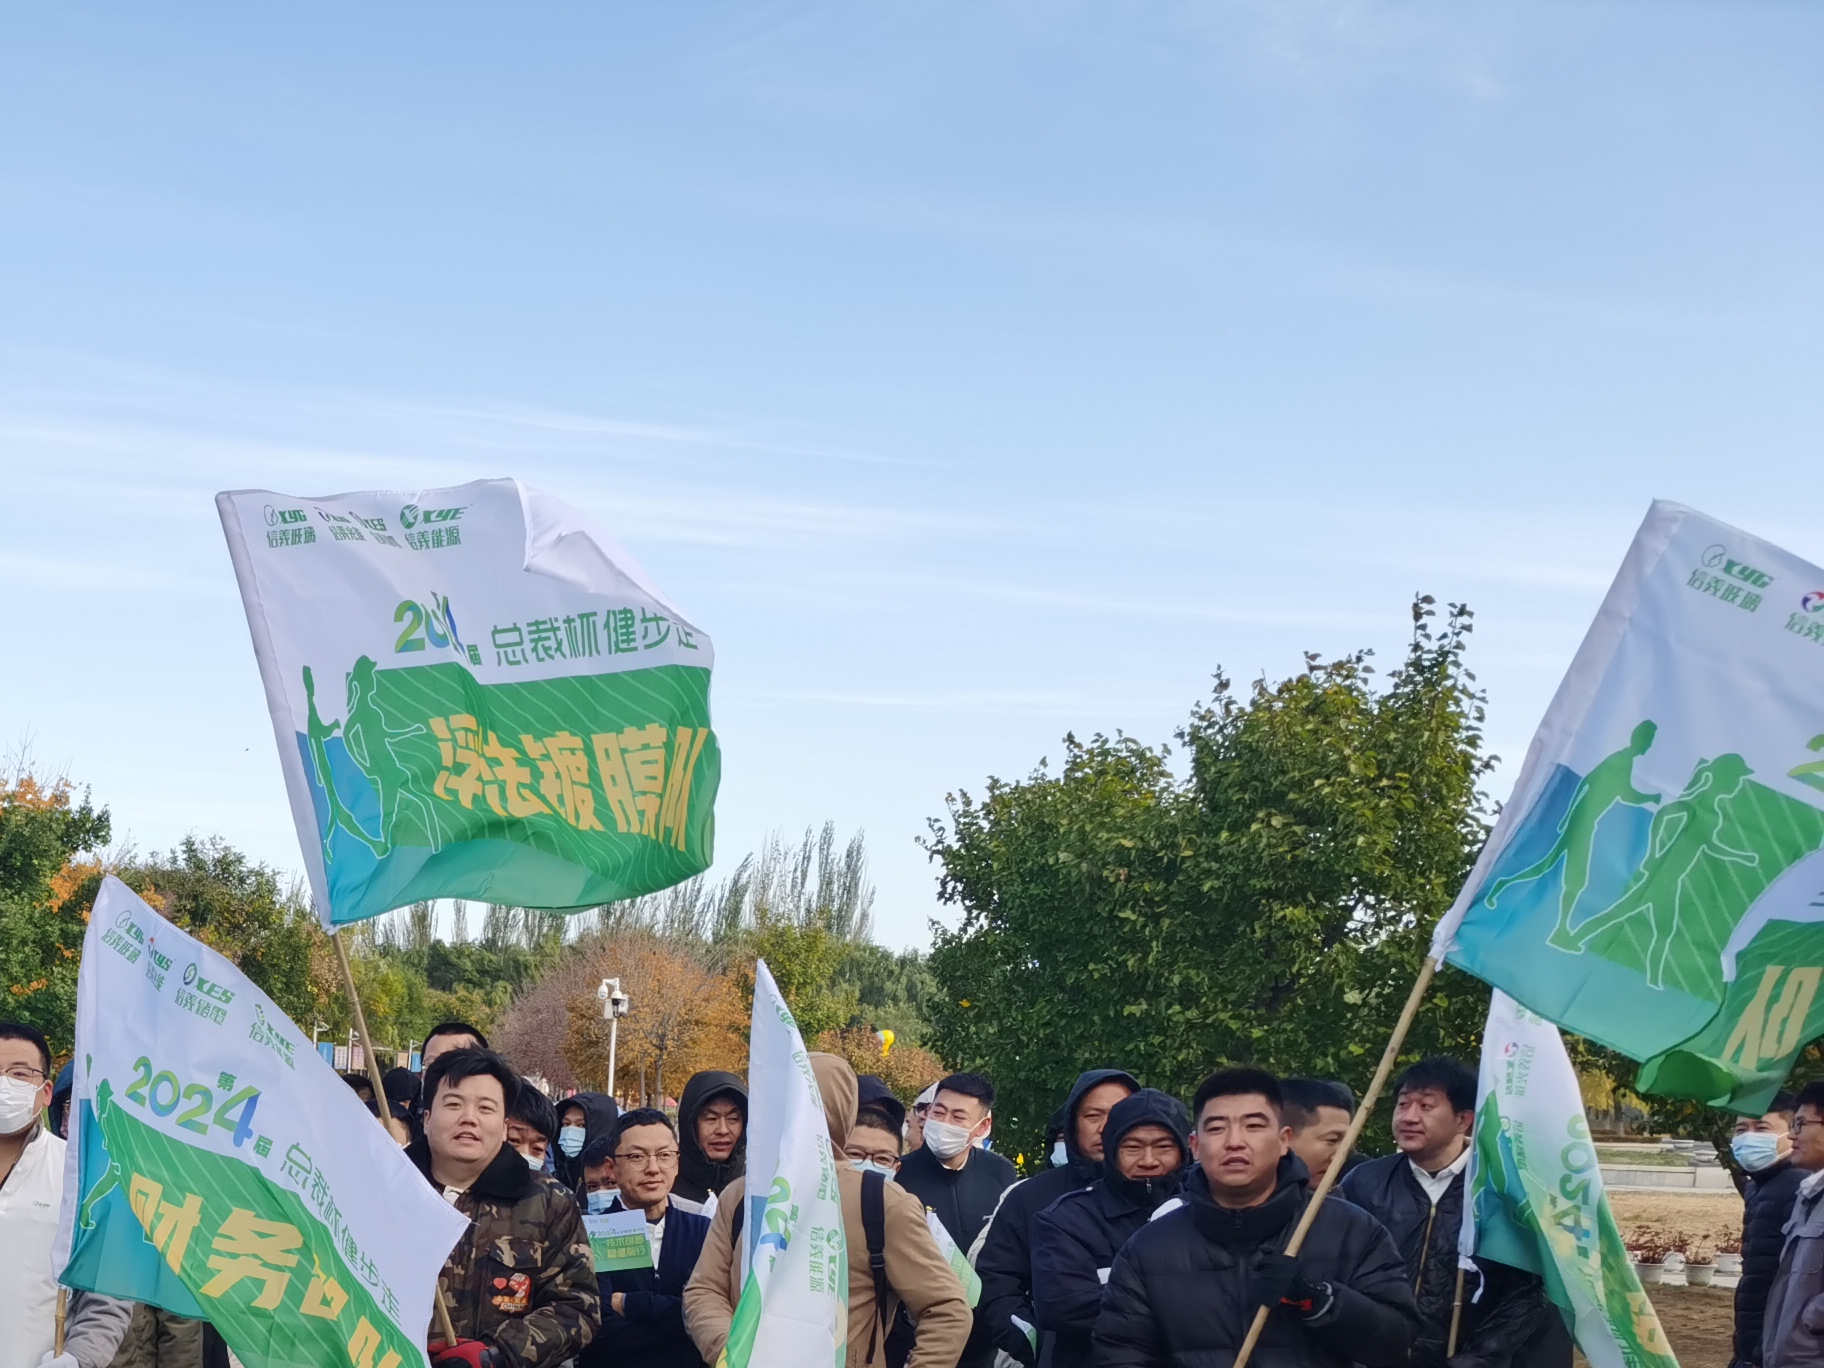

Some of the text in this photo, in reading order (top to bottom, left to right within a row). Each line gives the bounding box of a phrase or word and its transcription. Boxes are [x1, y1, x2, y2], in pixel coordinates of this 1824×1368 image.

[124, 1056, 263, 1148] 2024
[280, 1142, 402, 1326] 总裁杯健步走
